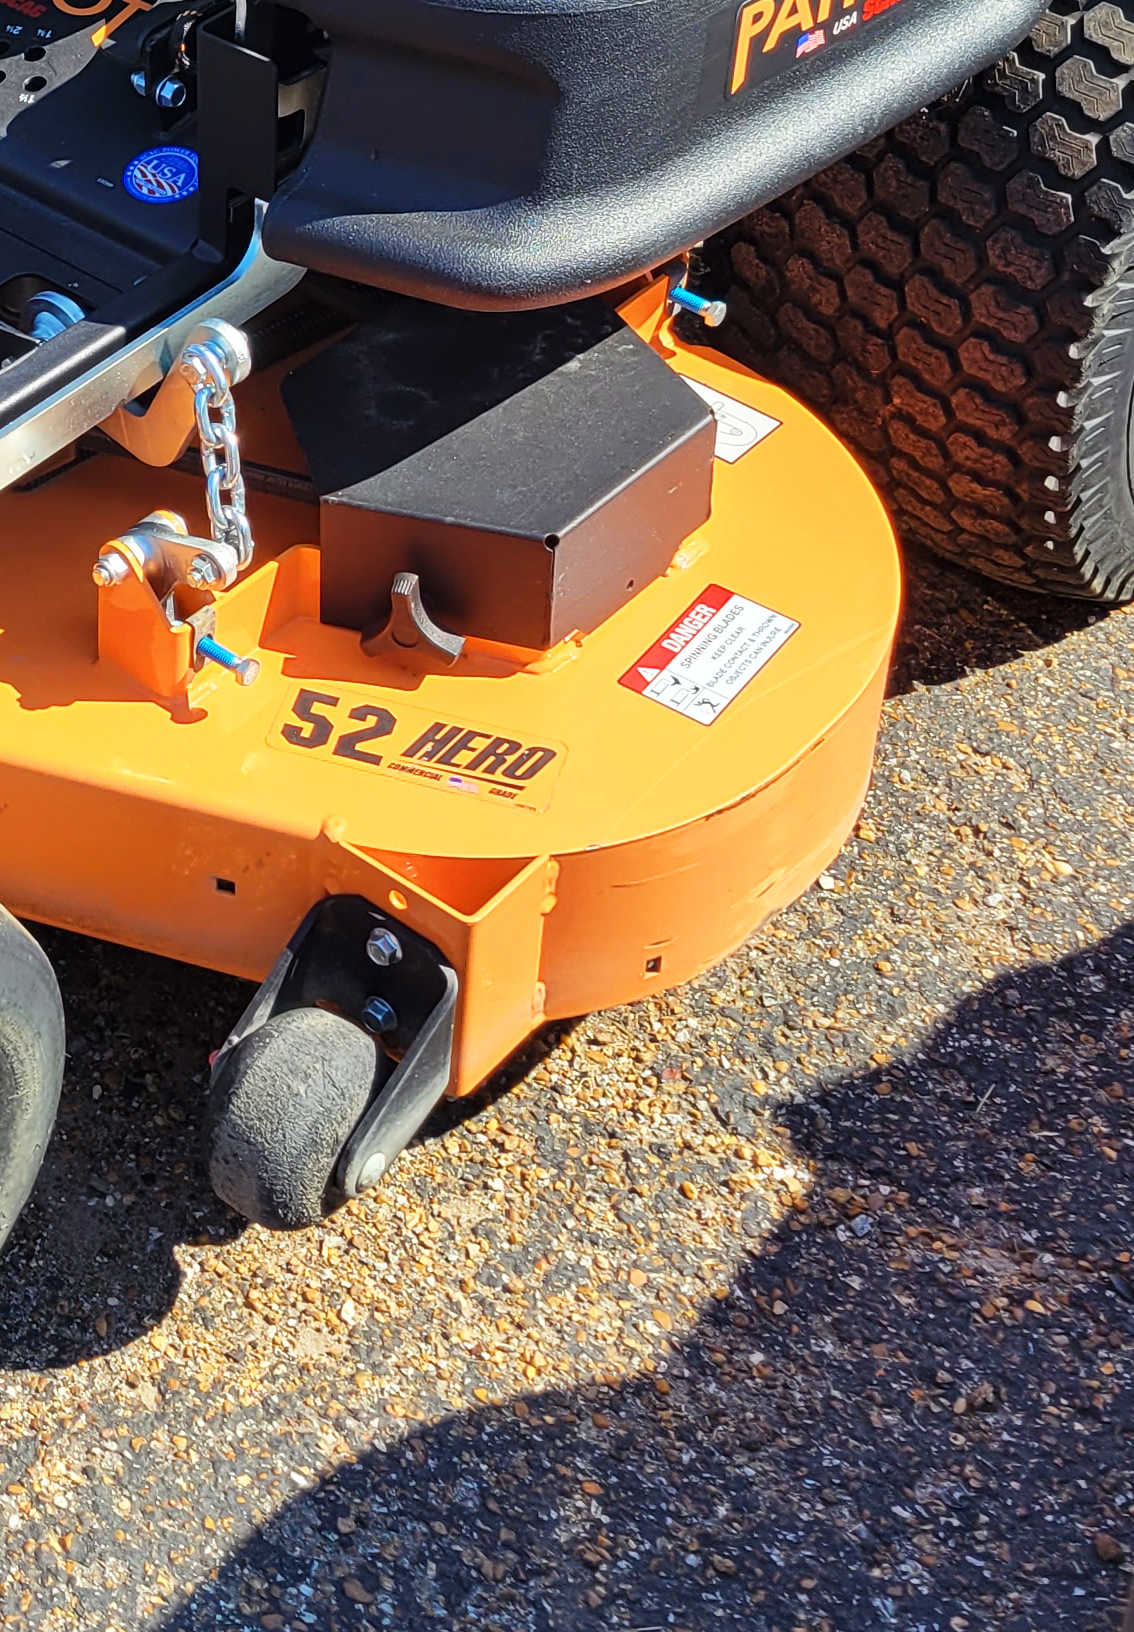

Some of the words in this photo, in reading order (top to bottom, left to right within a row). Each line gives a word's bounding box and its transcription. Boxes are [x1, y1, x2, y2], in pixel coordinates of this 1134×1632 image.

[832, 10, 858, 36] USA
[147, 159, 186, 187] USA
[660, 603, 718, 653] DANGER
[680, 632, 718, 669] SPINNING
[713, 604, 745, 634] BLADES
[706, 666, 727, 688] BLADE
[723, 641, 749, 669] CONTACT
[751, 613, 777, 638] THROWN
[710, 644, 726, 660] KEEP
[725, 626, 745, 646] CLEAR
[725, 658, 753, 685] OBJECTS
[748, 648, 762, 660] CAN
[759, 626, 782, 650] INJURE
[280, 688, 398, 766] 52
[399, 721, 558, 781] HERO
[387, 762, 444, 782] COMMERCIAL
[488, 787, 518, 800] GRADE
